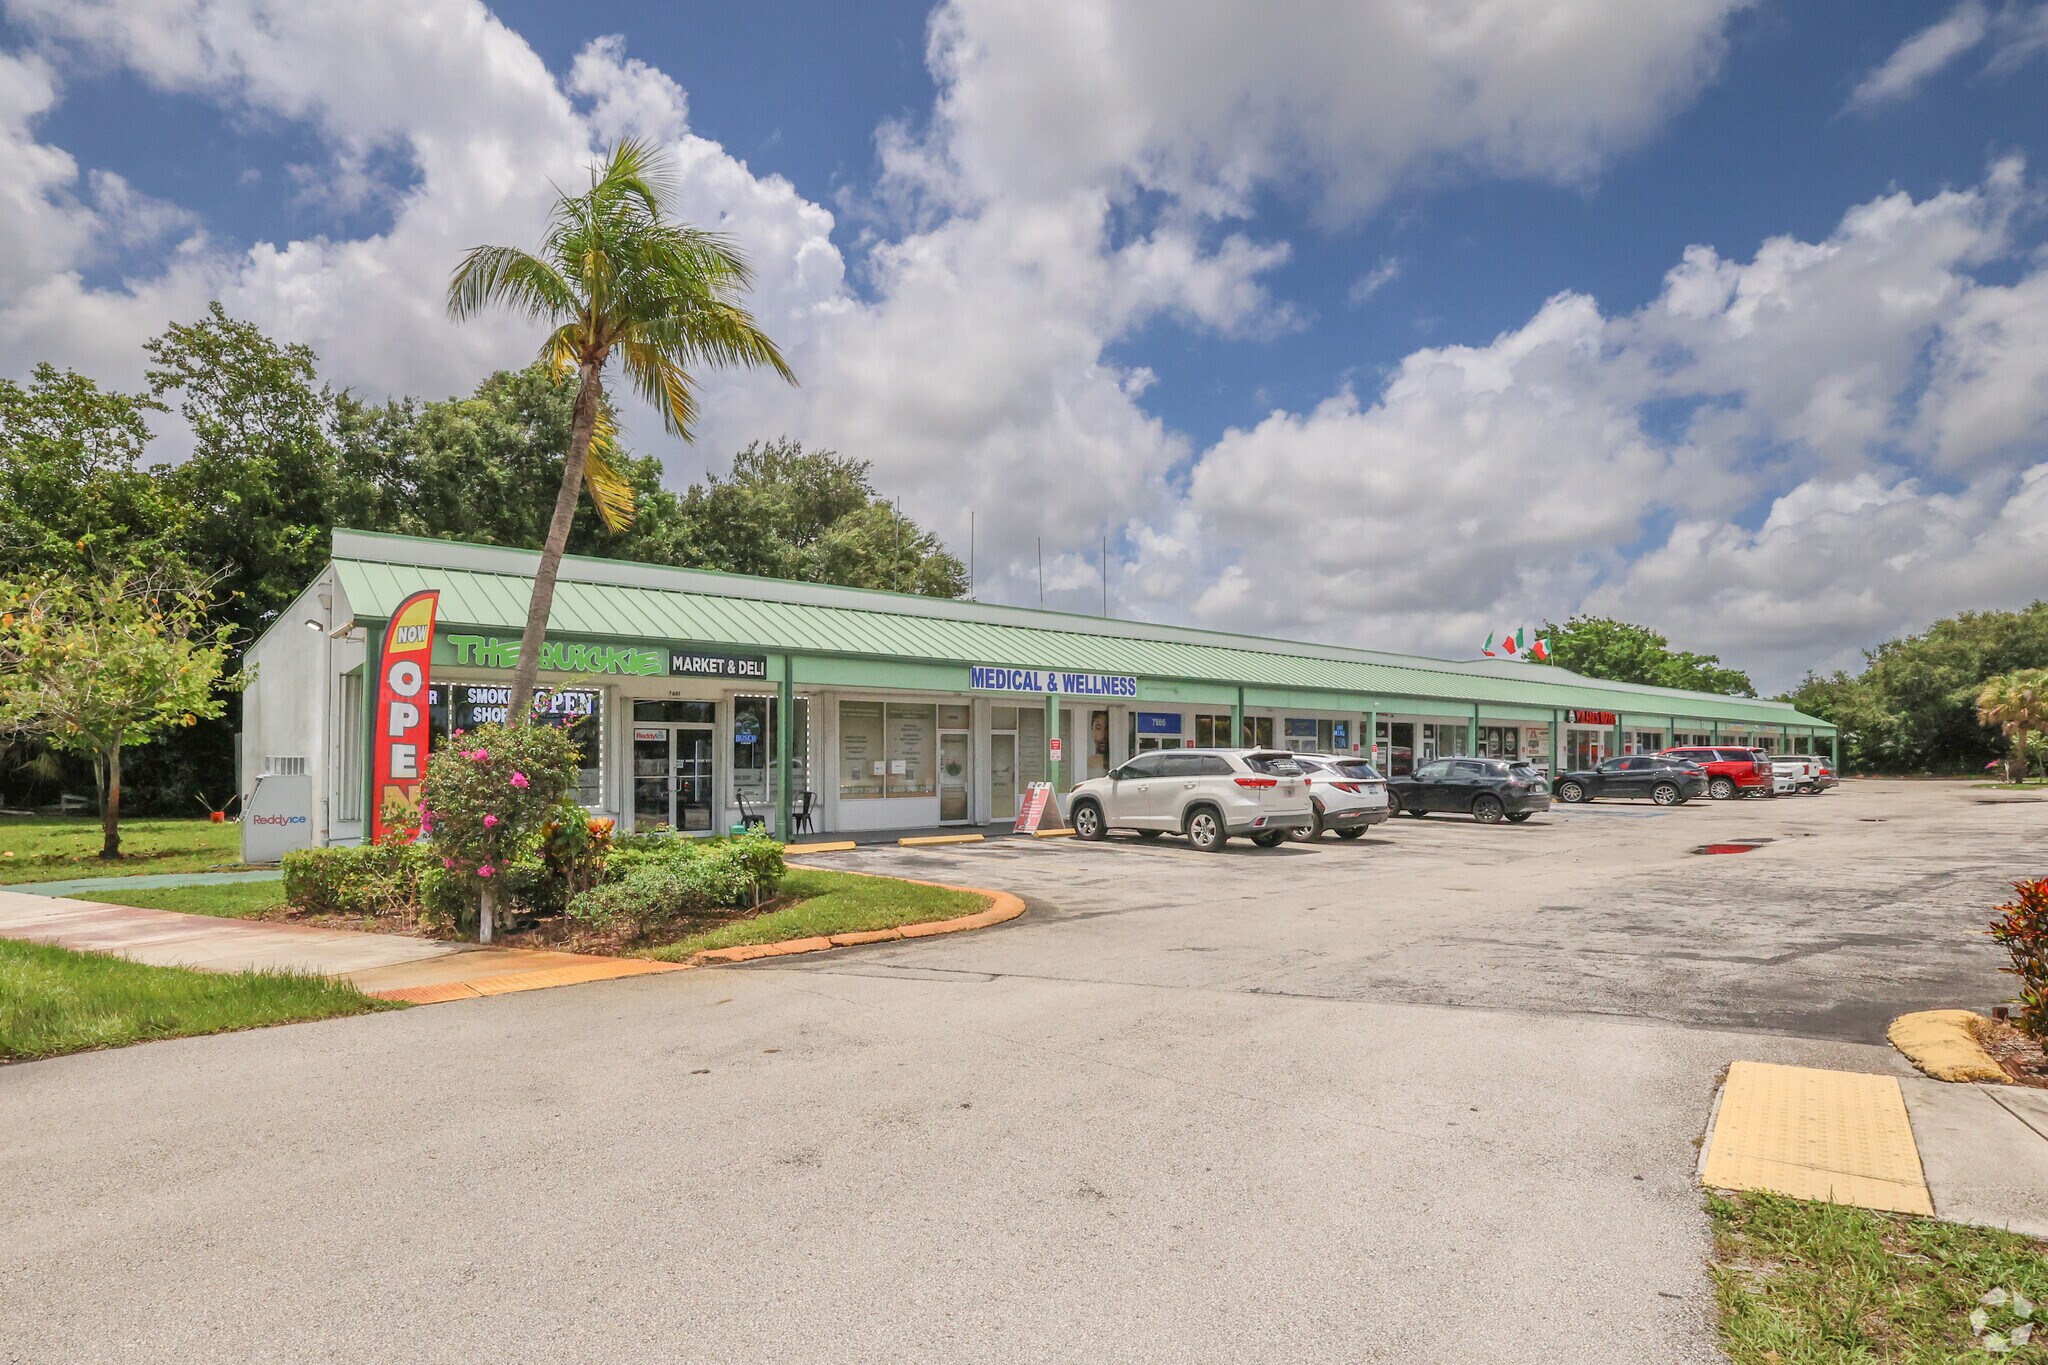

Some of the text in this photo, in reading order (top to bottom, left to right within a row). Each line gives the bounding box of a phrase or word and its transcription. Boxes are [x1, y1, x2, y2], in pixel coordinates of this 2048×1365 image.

[397, 624, 428, 644] NOW
[447, 635, 524, 668] THE
[672, 656, 765, 676] MARKET & DELI
[971, 667, 1136, 696] MEDICAL & WELLNESS
[534, 692, 593, 714] OPEN
[383, 660, 424, 819] OPEN
